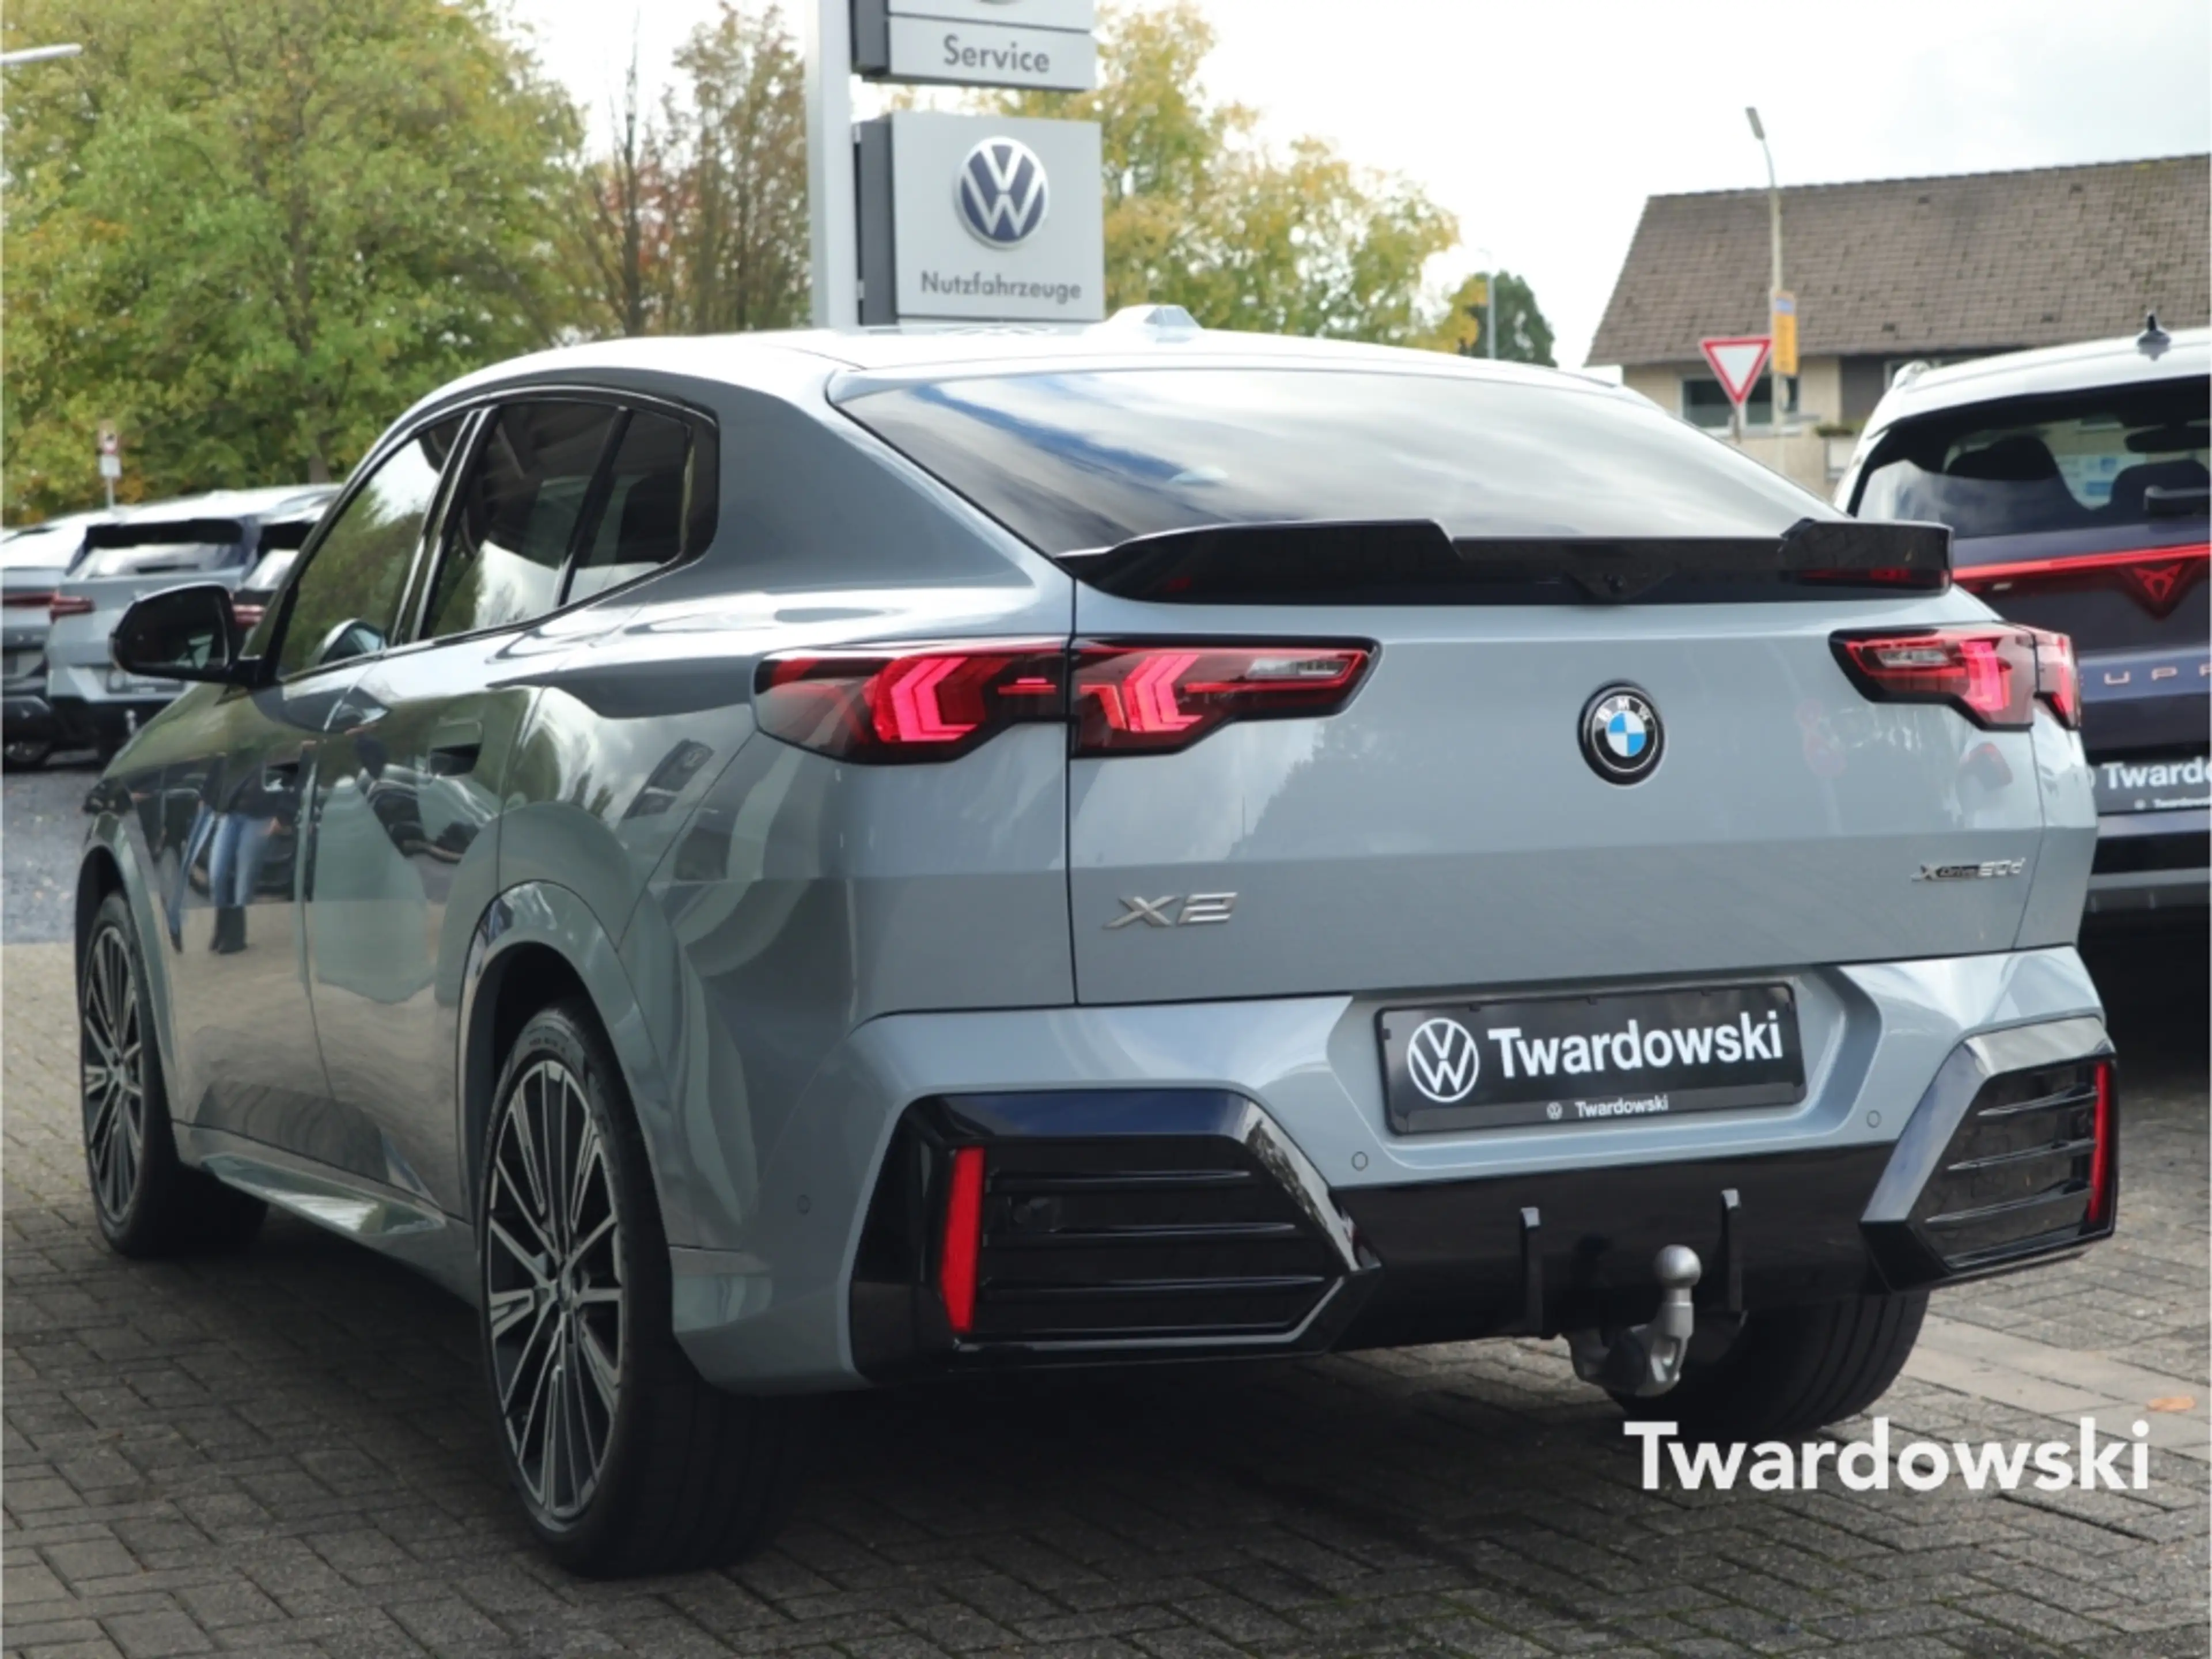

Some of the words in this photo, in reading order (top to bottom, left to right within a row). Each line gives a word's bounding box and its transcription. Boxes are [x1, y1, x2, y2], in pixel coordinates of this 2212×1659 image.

[943, 34, 1051, 73] Service
[921, 271, 1082, 304] Nutzfahrzeuge
[1102, 891, 1238, 929] X2
[1488, 1010, 1783, 1080] Twardowski
[1574, 1092, 1669, 1119] Twardowski
